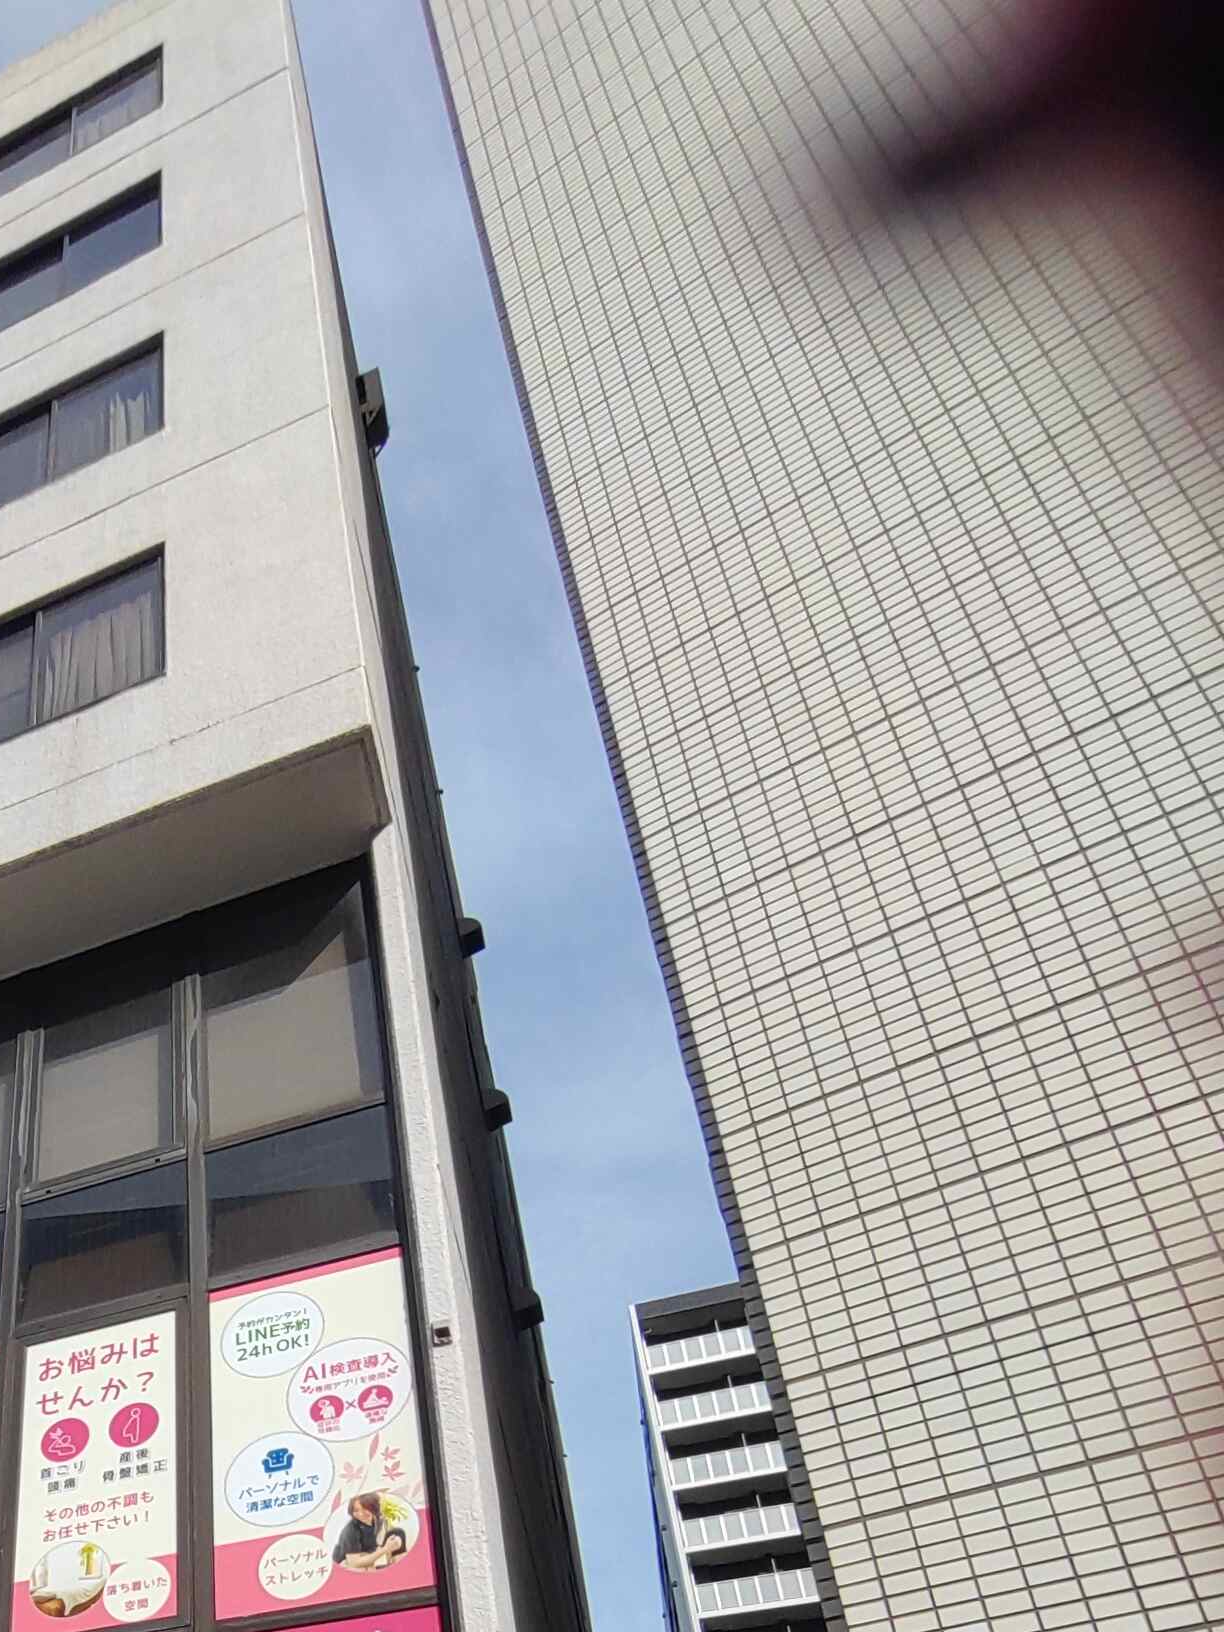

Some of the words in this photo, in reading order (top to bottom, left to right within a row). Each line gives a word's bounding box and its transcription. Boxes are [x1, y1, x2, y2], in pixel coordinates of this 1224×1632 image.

[38, 1332, 160, 1383] お悩みは
[36, 1371, 155, 1416] せんか？
[44, 1490, 154, 1522] その他の不調も
